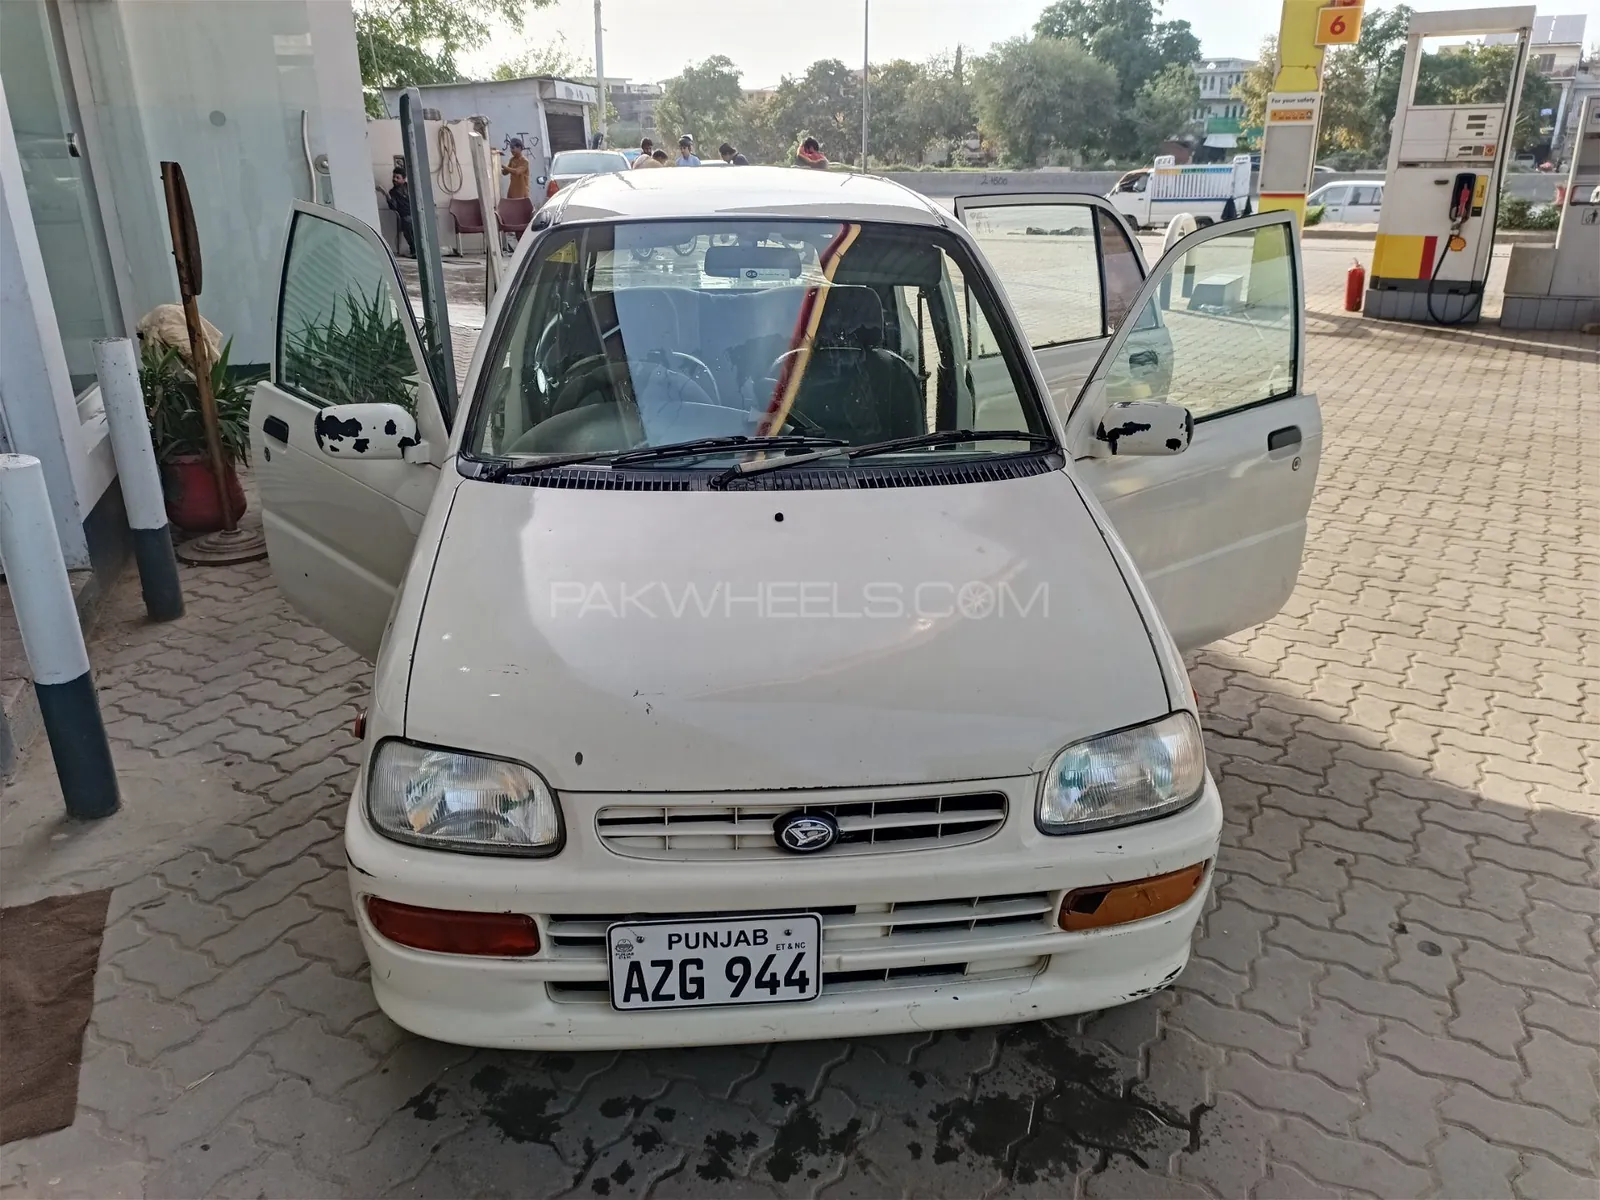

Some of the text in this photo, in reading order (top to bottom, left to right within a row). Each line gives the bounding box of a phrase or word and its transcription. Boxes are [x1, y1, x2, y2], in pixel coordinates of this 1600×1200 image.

[1330, 15, 1346, 36] 6
[1282, 97, 1296, 105] your
[667, 928, 769, 951] PUNJAB
[795, 942, 806, 950] NC
[623, 952, 810, 1003] AZG 944
